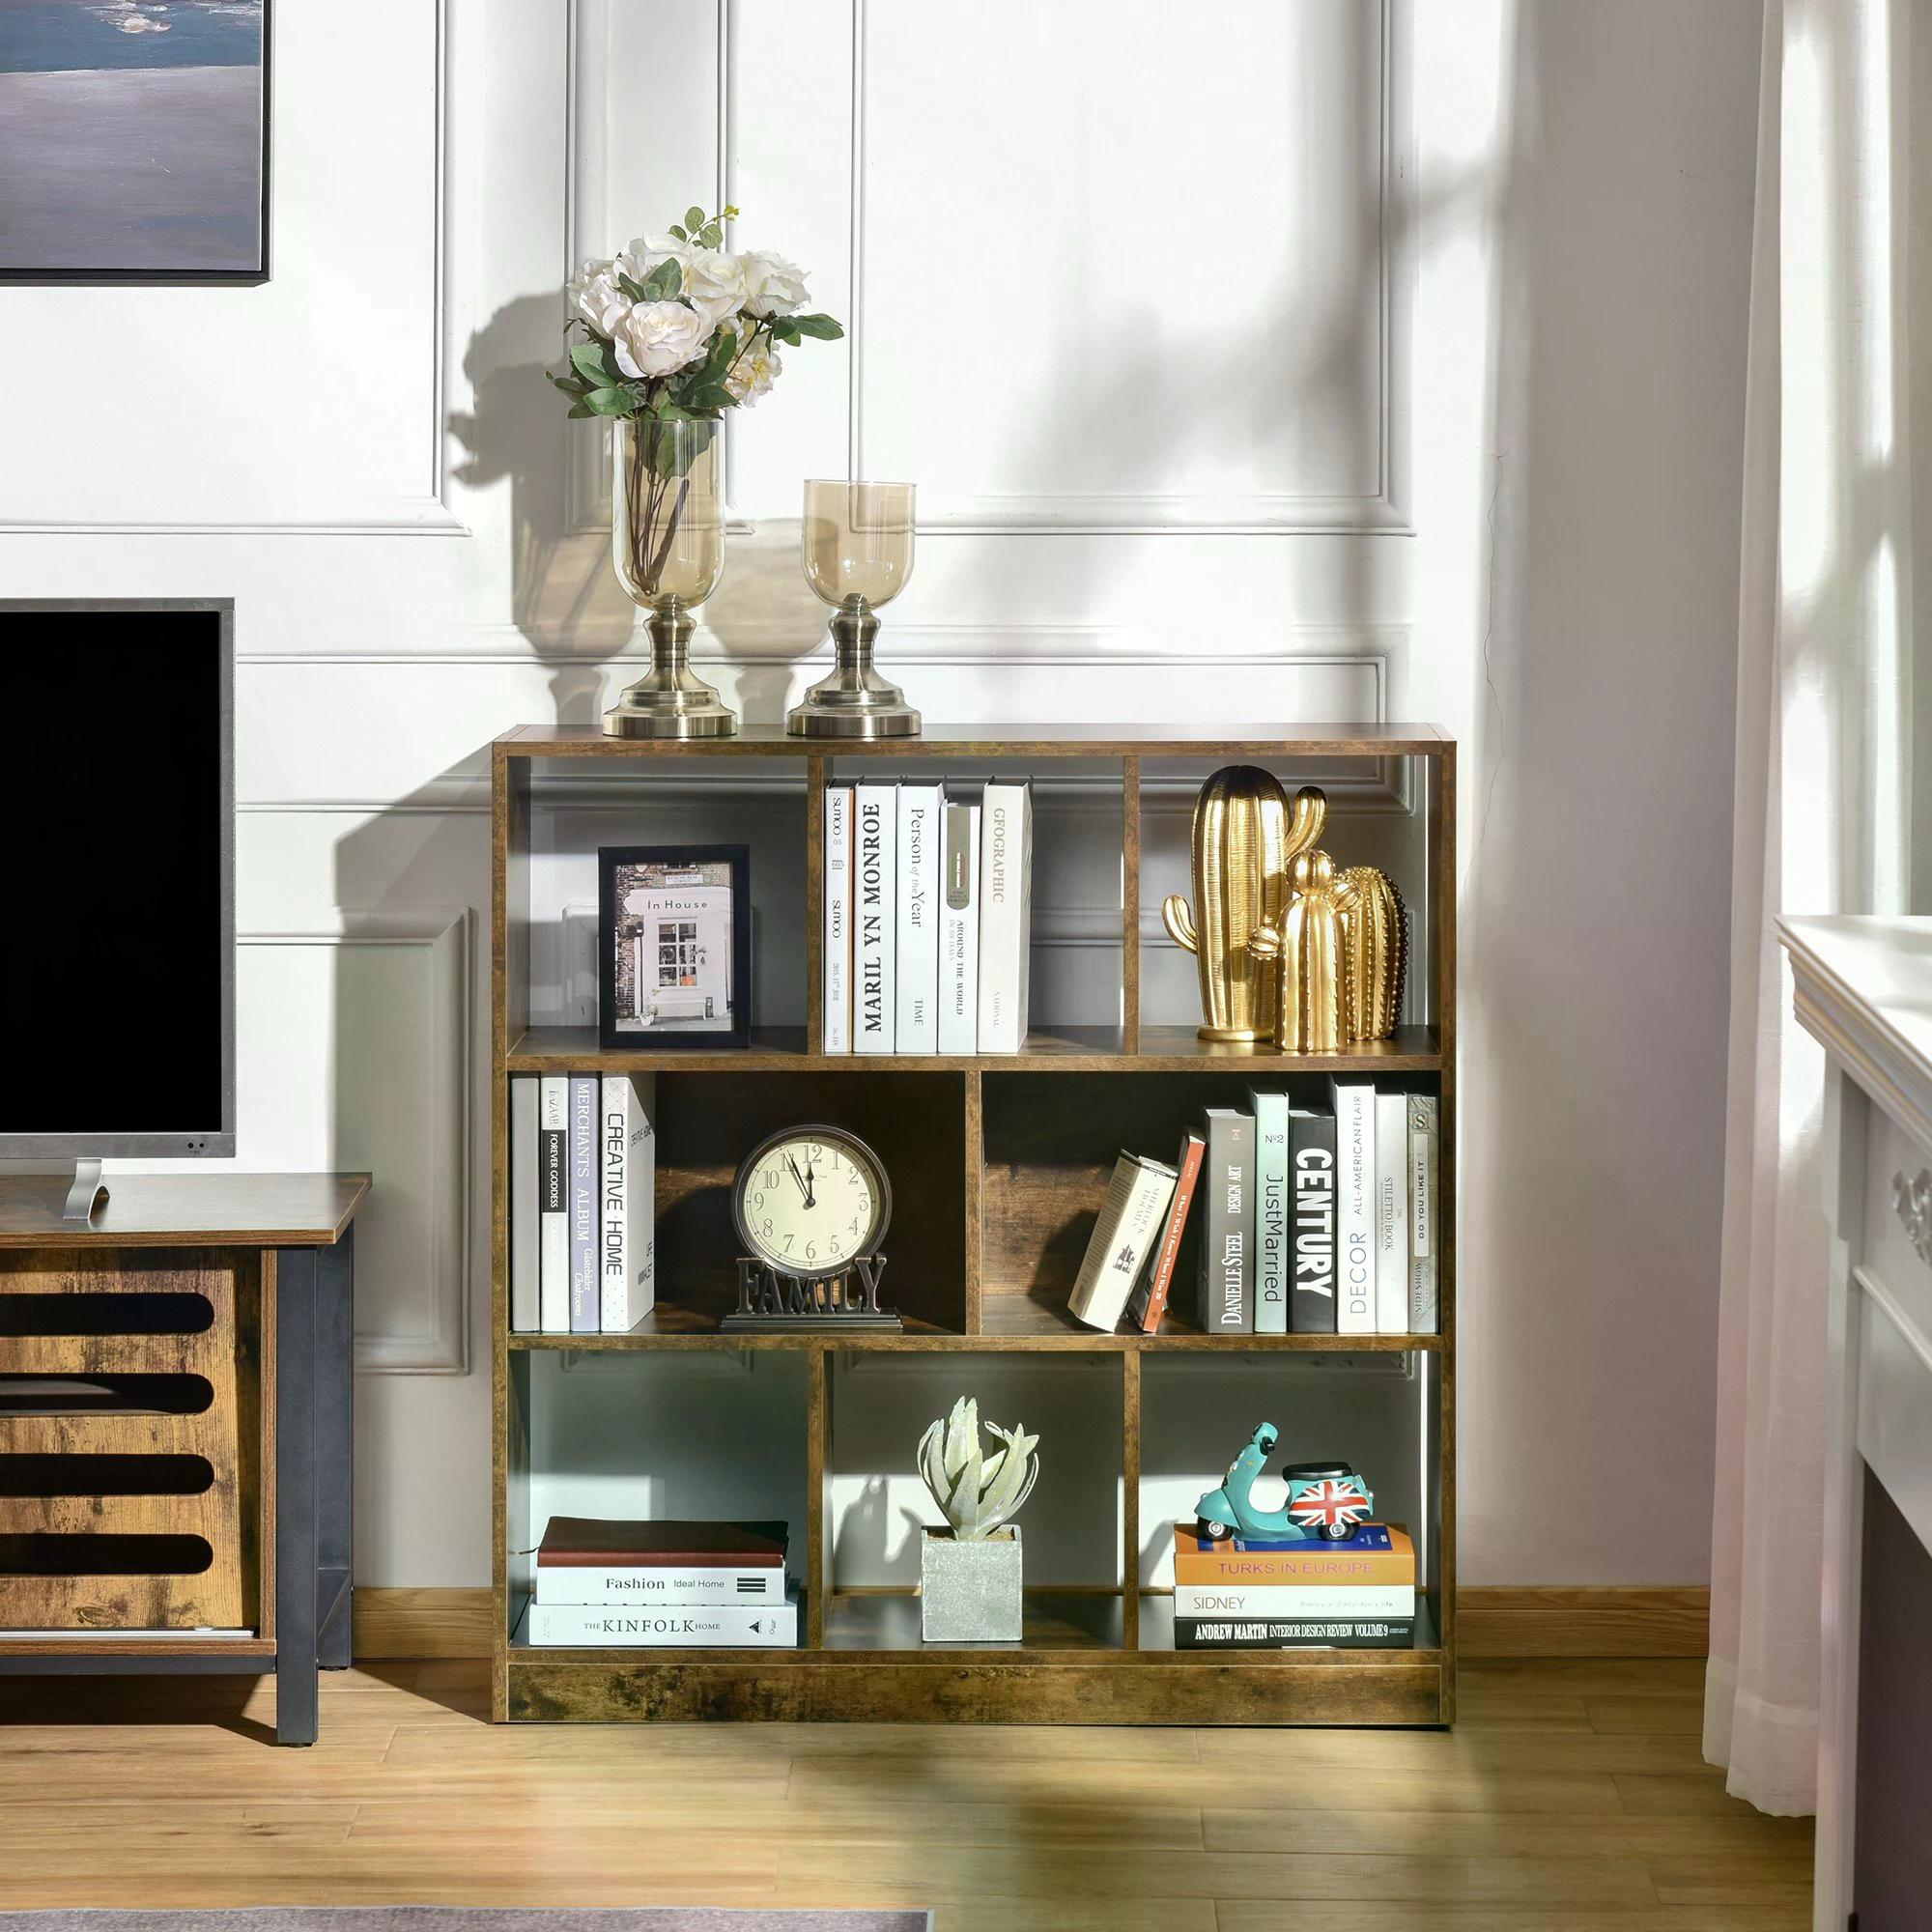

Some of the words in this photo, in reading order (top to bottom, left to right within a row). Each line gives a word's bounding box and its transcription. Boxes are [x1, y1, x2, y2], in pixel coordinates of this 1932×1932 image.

[911, 809, 924, 865] Person
[863, 804, 880, 905] MONROE
[647, 900, 660, 910] In
[665, 899, 708, 910] House
[911, 892, 924, 927] Year
[955, 980, 964, 1015] WORLD
[914, 997, 924, 1027] TIME
[577, 1083, 589, 1178] MERCHANTS
[550, 1134, 558, 1168] FOREVER
[607, 1113, 624, 1211] CREATIVE
[803, 1145, 823, 1163] 12
[832, 1151, 840, 1170] 1
[847, 1167, 860, 1185] 2
[1228, 1165, 1242, 1181] ART
[1417, 1160, 1425, 1171] IT
[550, 1170, 558, 1208] GODDESS
[762, 1170, 781, 1189] 10
[1417, 1172, 1426, 1197] LIKE
[753, 1192, 765, 1211] 9
[858, 1192, 869, 1212] 3
[1228, 1184, 1241, 1213] DESIGN
[1384, 1177, 1393, 1220] STILETTO
[577, 1188, 589, 1240] ALBUM
[846, 1216, 859, 1236] 4
[1295, 1148, 1333, 1298] CENTURY
[762, 1218, 774, 1237] 8
[1264, 1174, 1284, 1302] JustMarried
[1384, 1225, 1393, 1251] BOOK
[1418, 1224, 1426, 1239] DO
[606, 1220, 623, 1276] HOME
[783, 1234, 795, 1253] 7
[805, 1240, 815, 1260] 6
[829, 1235, 840, 1254] 5
[1221, 1232, 1243, 1267] STEEL
[735, 1256, 887, 1315] FAMILY
[1350, 1232, 1367, 1314] DECOR
[1221, 1267, 1243, 1324] DANIELLE
[1414, 1262, 1423, 1313] SIDESHOW
[1218, 1562, 1275, 1575] TURKS
[1281, 1562, 1297, 1575] IN
[1302, 1562, 1376, 1575] EUROPE
[606, 1577, 666, 1589] Fashion
[673, 1579, 696, 1589] Ideal
[697, 1579, 724, 1589] Home
[1193, 1597, 1246, 1610] SIDNEY
[602, 1619, 695, 1633] KINFOLK
[1195, 1624, 1234, 1640] ANDREW
[1234, 1624, 1267, 1640] MARTIN
[1269, 1625, 1301, 1637] INTERIOR
[1301, 1625, 1326, 1637] DESIGN
[1326, 1625, 1353, 1637] REVIEW
[1354, 1624, 1383, 1637] VOLUME
[1383, 1624, 1388, 1637] 9
